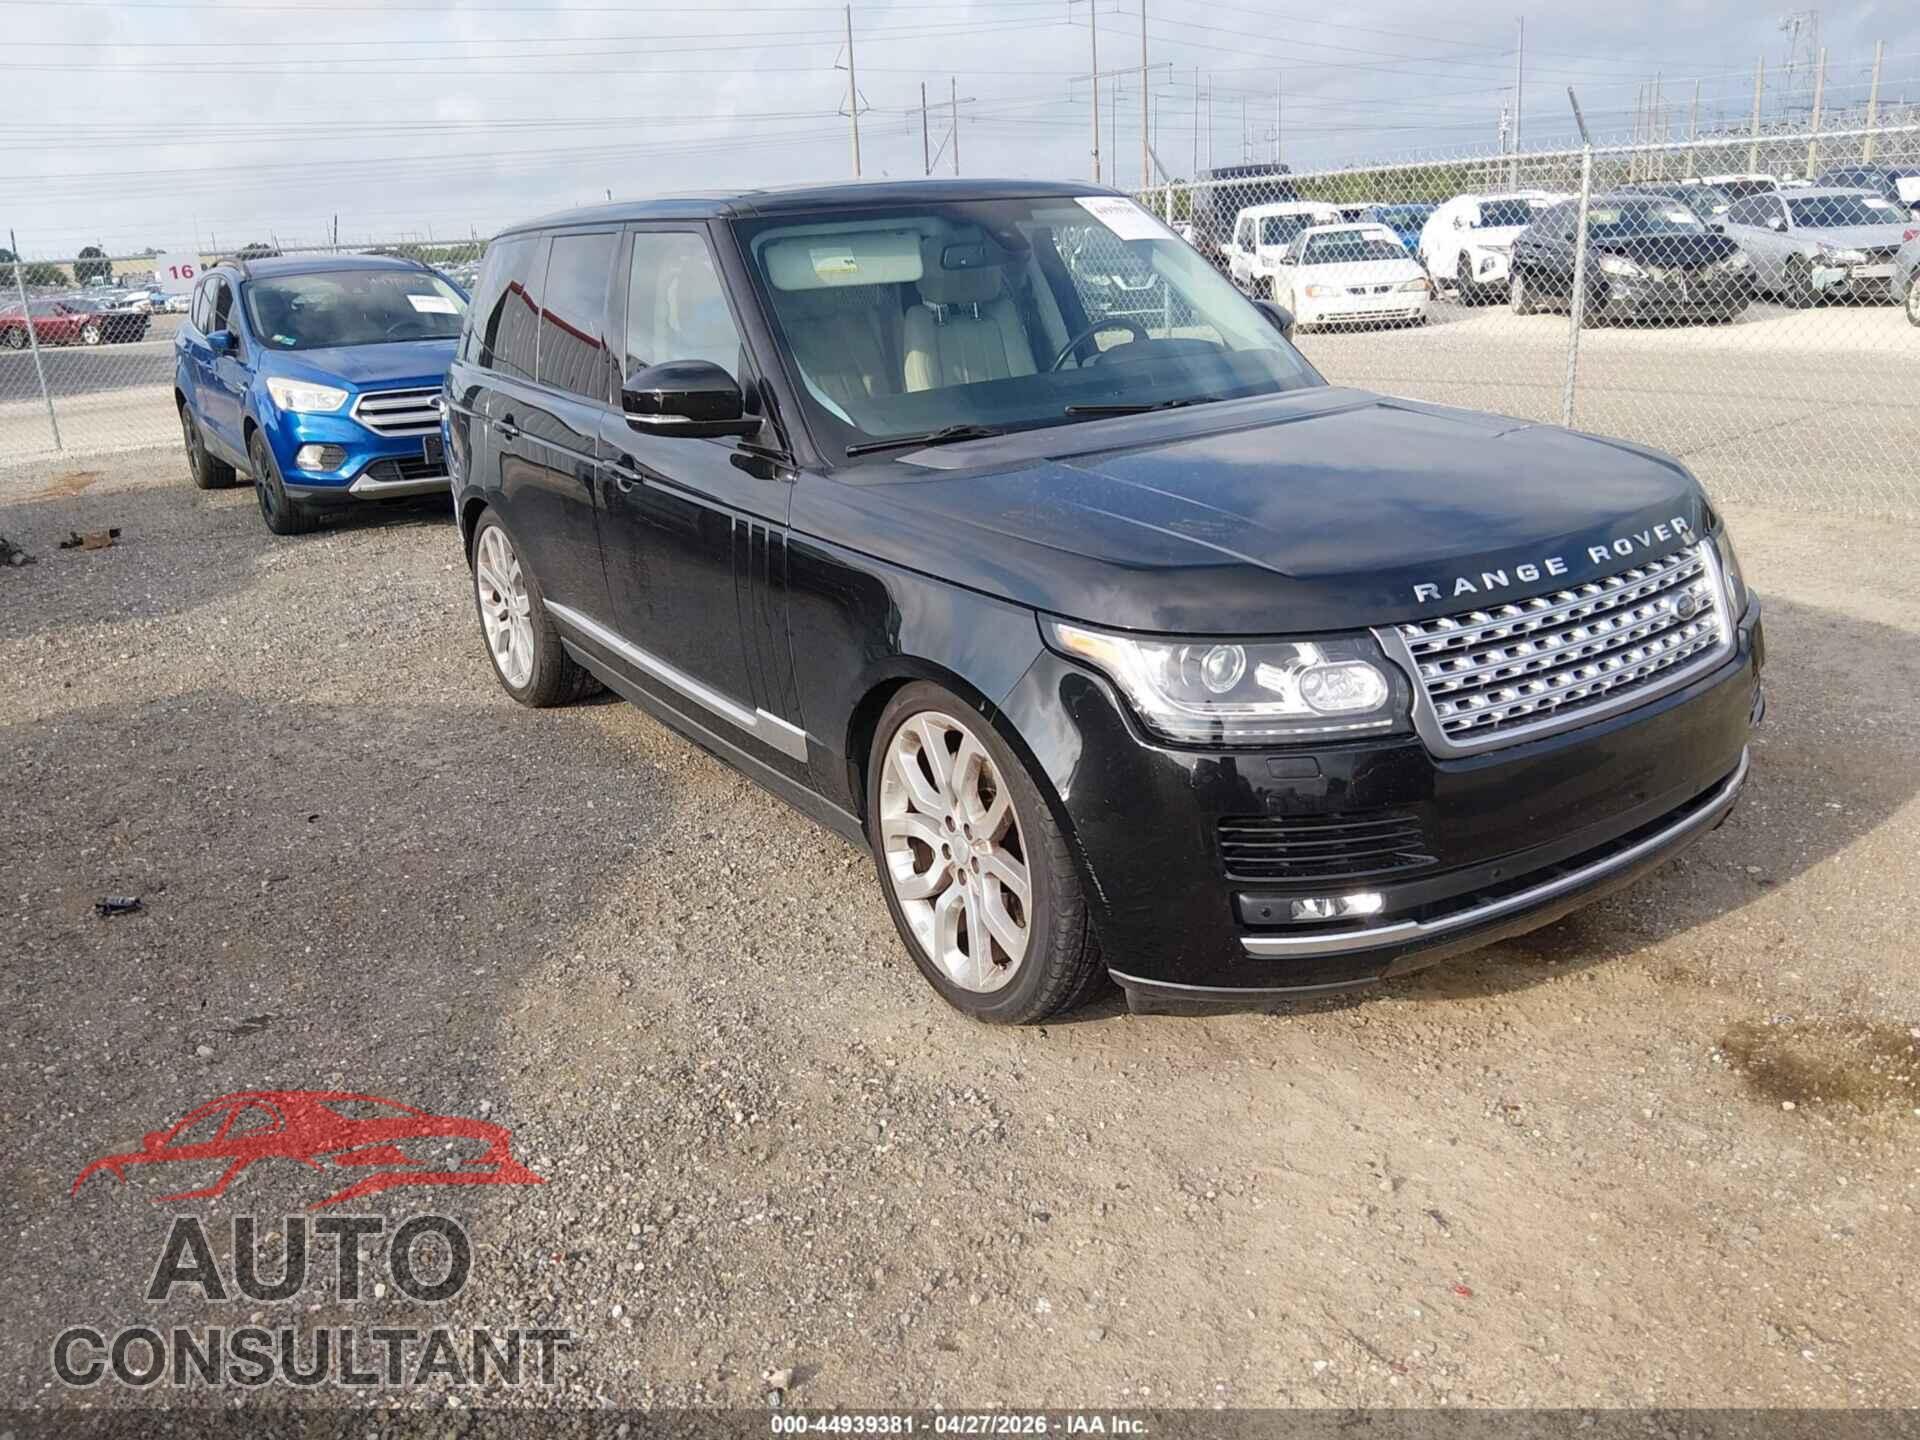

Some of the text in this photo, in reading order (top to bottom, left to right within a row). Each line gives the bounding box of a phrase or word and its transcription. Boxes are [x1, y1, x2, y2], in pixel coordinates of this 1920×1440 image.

[168, 264, 194, 280] 16
[1412, 515, 1690, 603] RANGE ROVER
